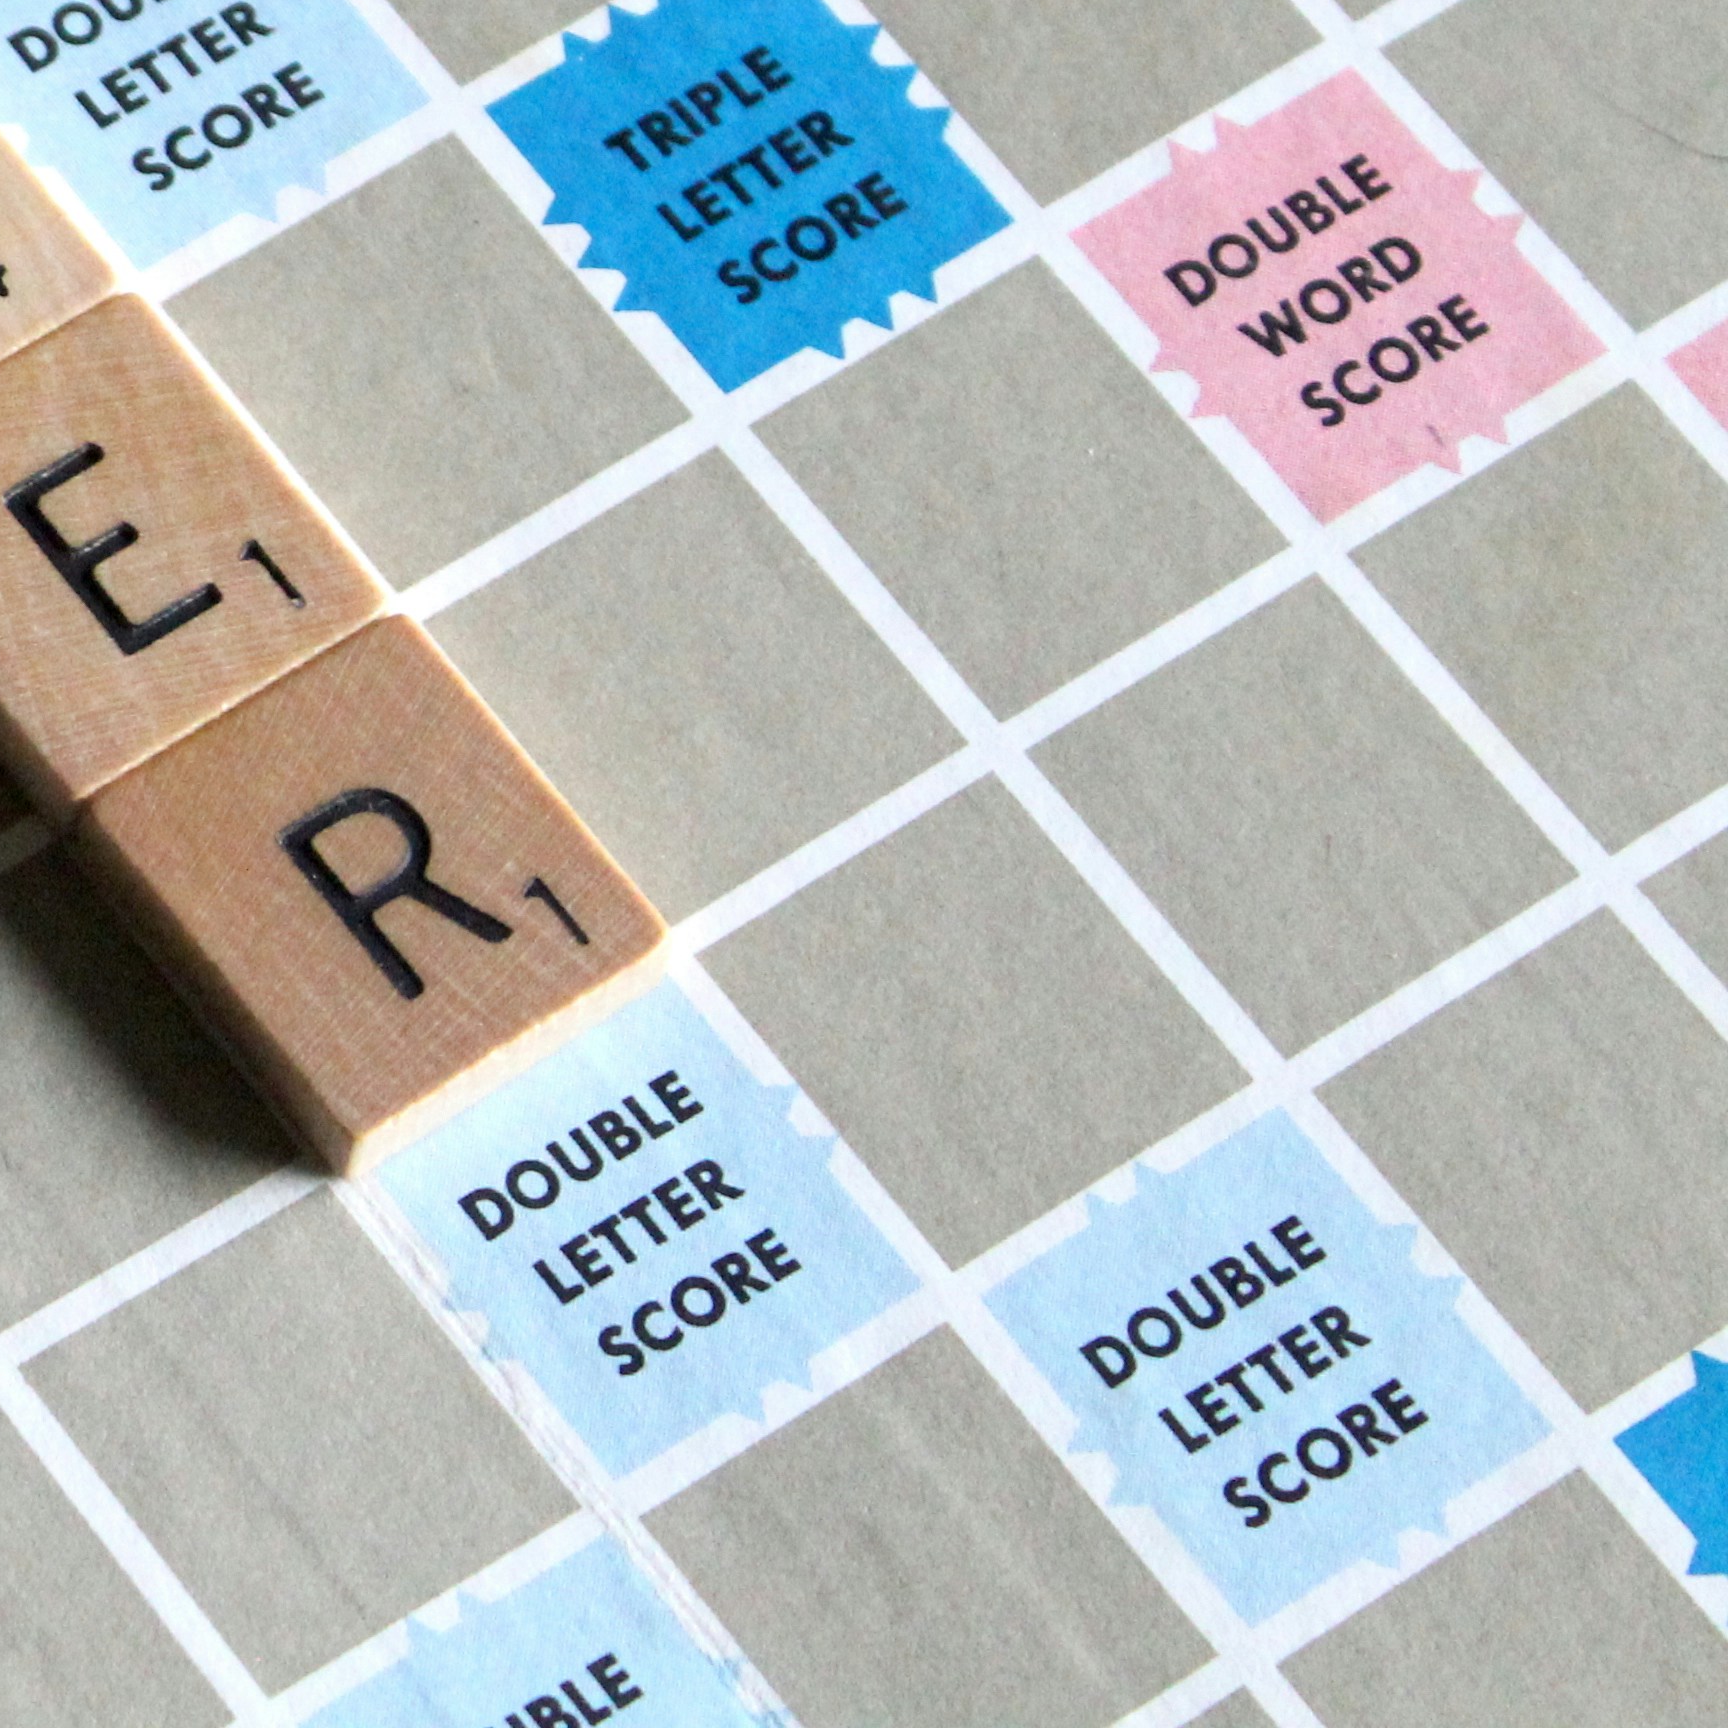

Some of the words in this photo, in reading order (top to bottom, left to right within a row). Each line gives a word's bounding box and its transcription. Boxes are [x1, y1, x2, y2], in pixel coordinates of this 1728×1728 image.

[74, 1, 274, 130] LETTER
[132, 62, 325, 193] SCORE
[603, 46, 794, 173] TRIPLE
[656, 110, 855, 243] LETTER
[716, 171, 909, 306] SCORE
[1162, 153, 1393, 309] DOUBLE
[1236, 236, 1423, 359] WORD
[1299, 293, 1490, 428] SCORE
[3, 440, 224, 657] E
[240, 538, 307, 610] 1
[277, 784, 511, 1001] R
[522, 875, 591, 947] 1
[457, 1069, 705, 1243] DOUBLE
[532, 1159, 746, 1306] LETTER
[597, 1227, 803, 1378] SCORE
[1078, 1214, 1328, 1391] DOUBLE
[1158, 1305, 1373, 1455] LETTER
[1222, 1378, 1430, 1530] SCORE
[489, 1650, 644, 1728] BLE
